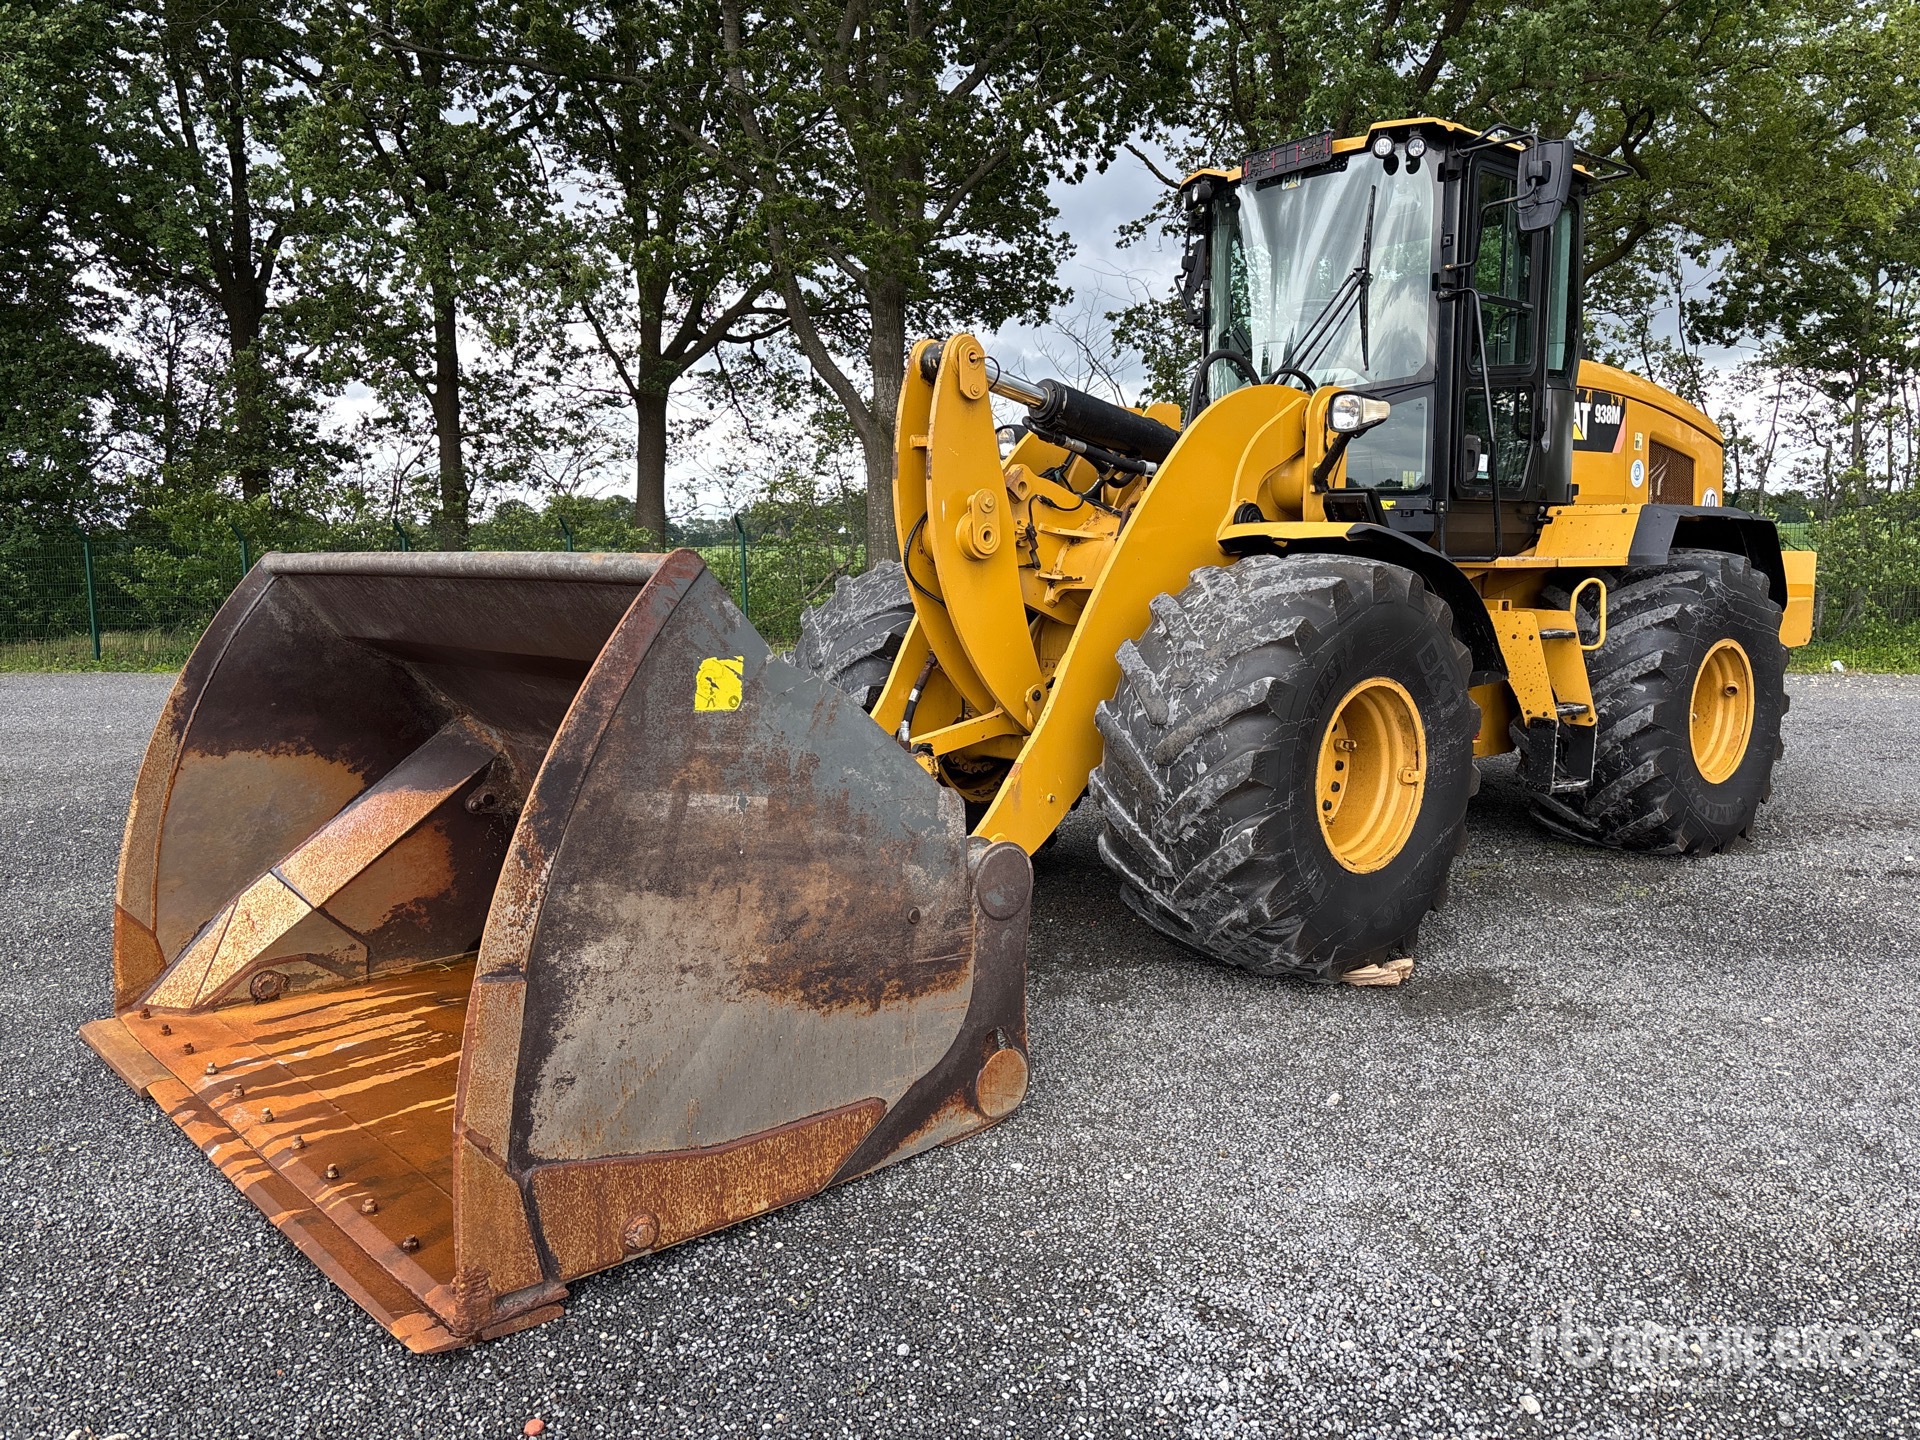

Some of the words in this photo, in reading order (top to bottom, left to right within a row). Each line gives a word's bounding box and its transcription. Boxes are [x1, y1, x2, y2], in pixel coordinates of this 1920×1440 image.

[1572, 401, 1590, 441] AT
[1594, 404, 1621, 425] 938M
[1704, 492, 1716, 507] 40
[1418, 641, 1462, 708] BKT
